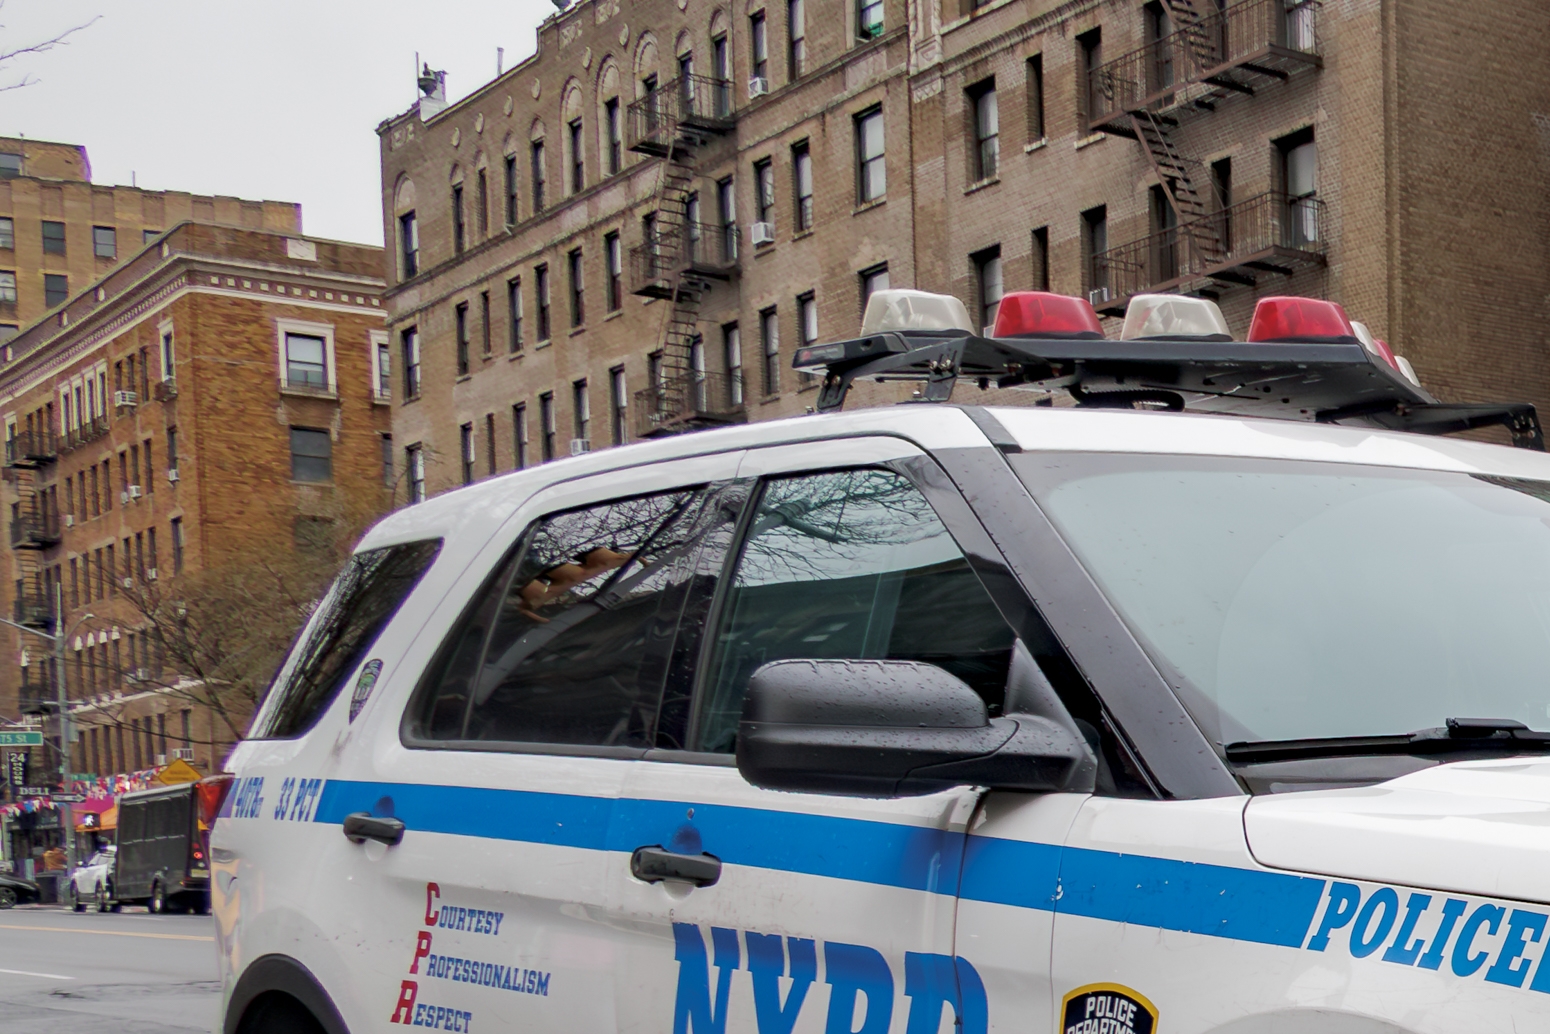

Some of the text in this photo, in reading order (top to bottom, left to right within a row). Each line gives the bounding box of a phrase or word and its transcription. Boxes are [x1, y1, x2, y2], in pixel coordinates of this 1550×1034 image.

[10, 752, 25, 763] 24
[19, 787, 50, 796] DELI
[274, 777, 295, 820] 33
[289, 778, 322, 822] PCT
[425, 881, 504, 936] COURTESY
[1306, 881, 1549, 989] POLICE
[409, 930, 551, 997] PROFESSIONALISM
[389, 980, 472, 1034] RESPECT
[1085, 996, 1137, 1028] POLICE
